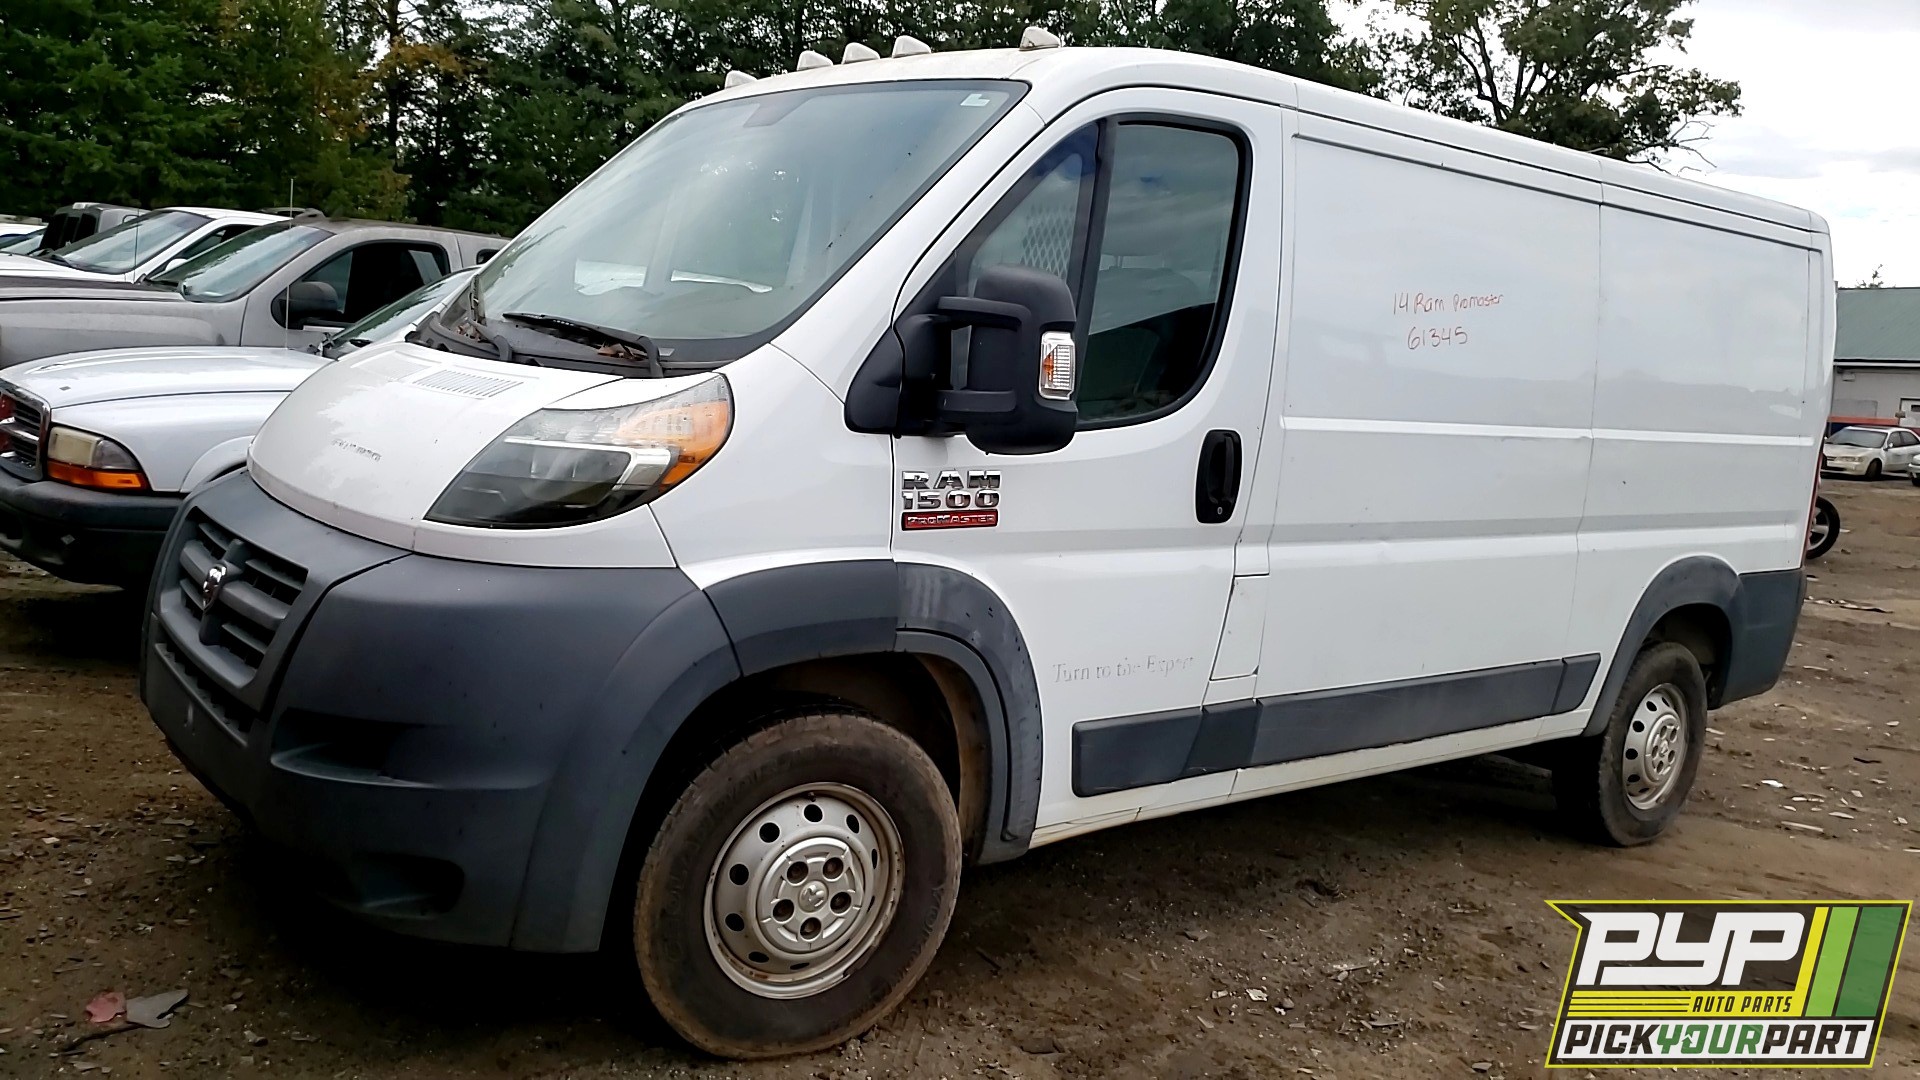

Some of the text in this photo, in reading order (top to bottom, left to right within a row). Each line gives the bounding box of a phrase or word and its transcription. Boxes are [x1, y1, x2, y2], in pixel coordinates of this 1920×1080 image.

[1393, 292, 1409, 315] 14
[1414, 292, 1445, 315] Ram
[1407, 326, 1468, 350] 61345
[902, 469, 1002, 490] RAM
[902, 489, 1000, 510] 1500
[1052, 662, 1090, 683] Turn
